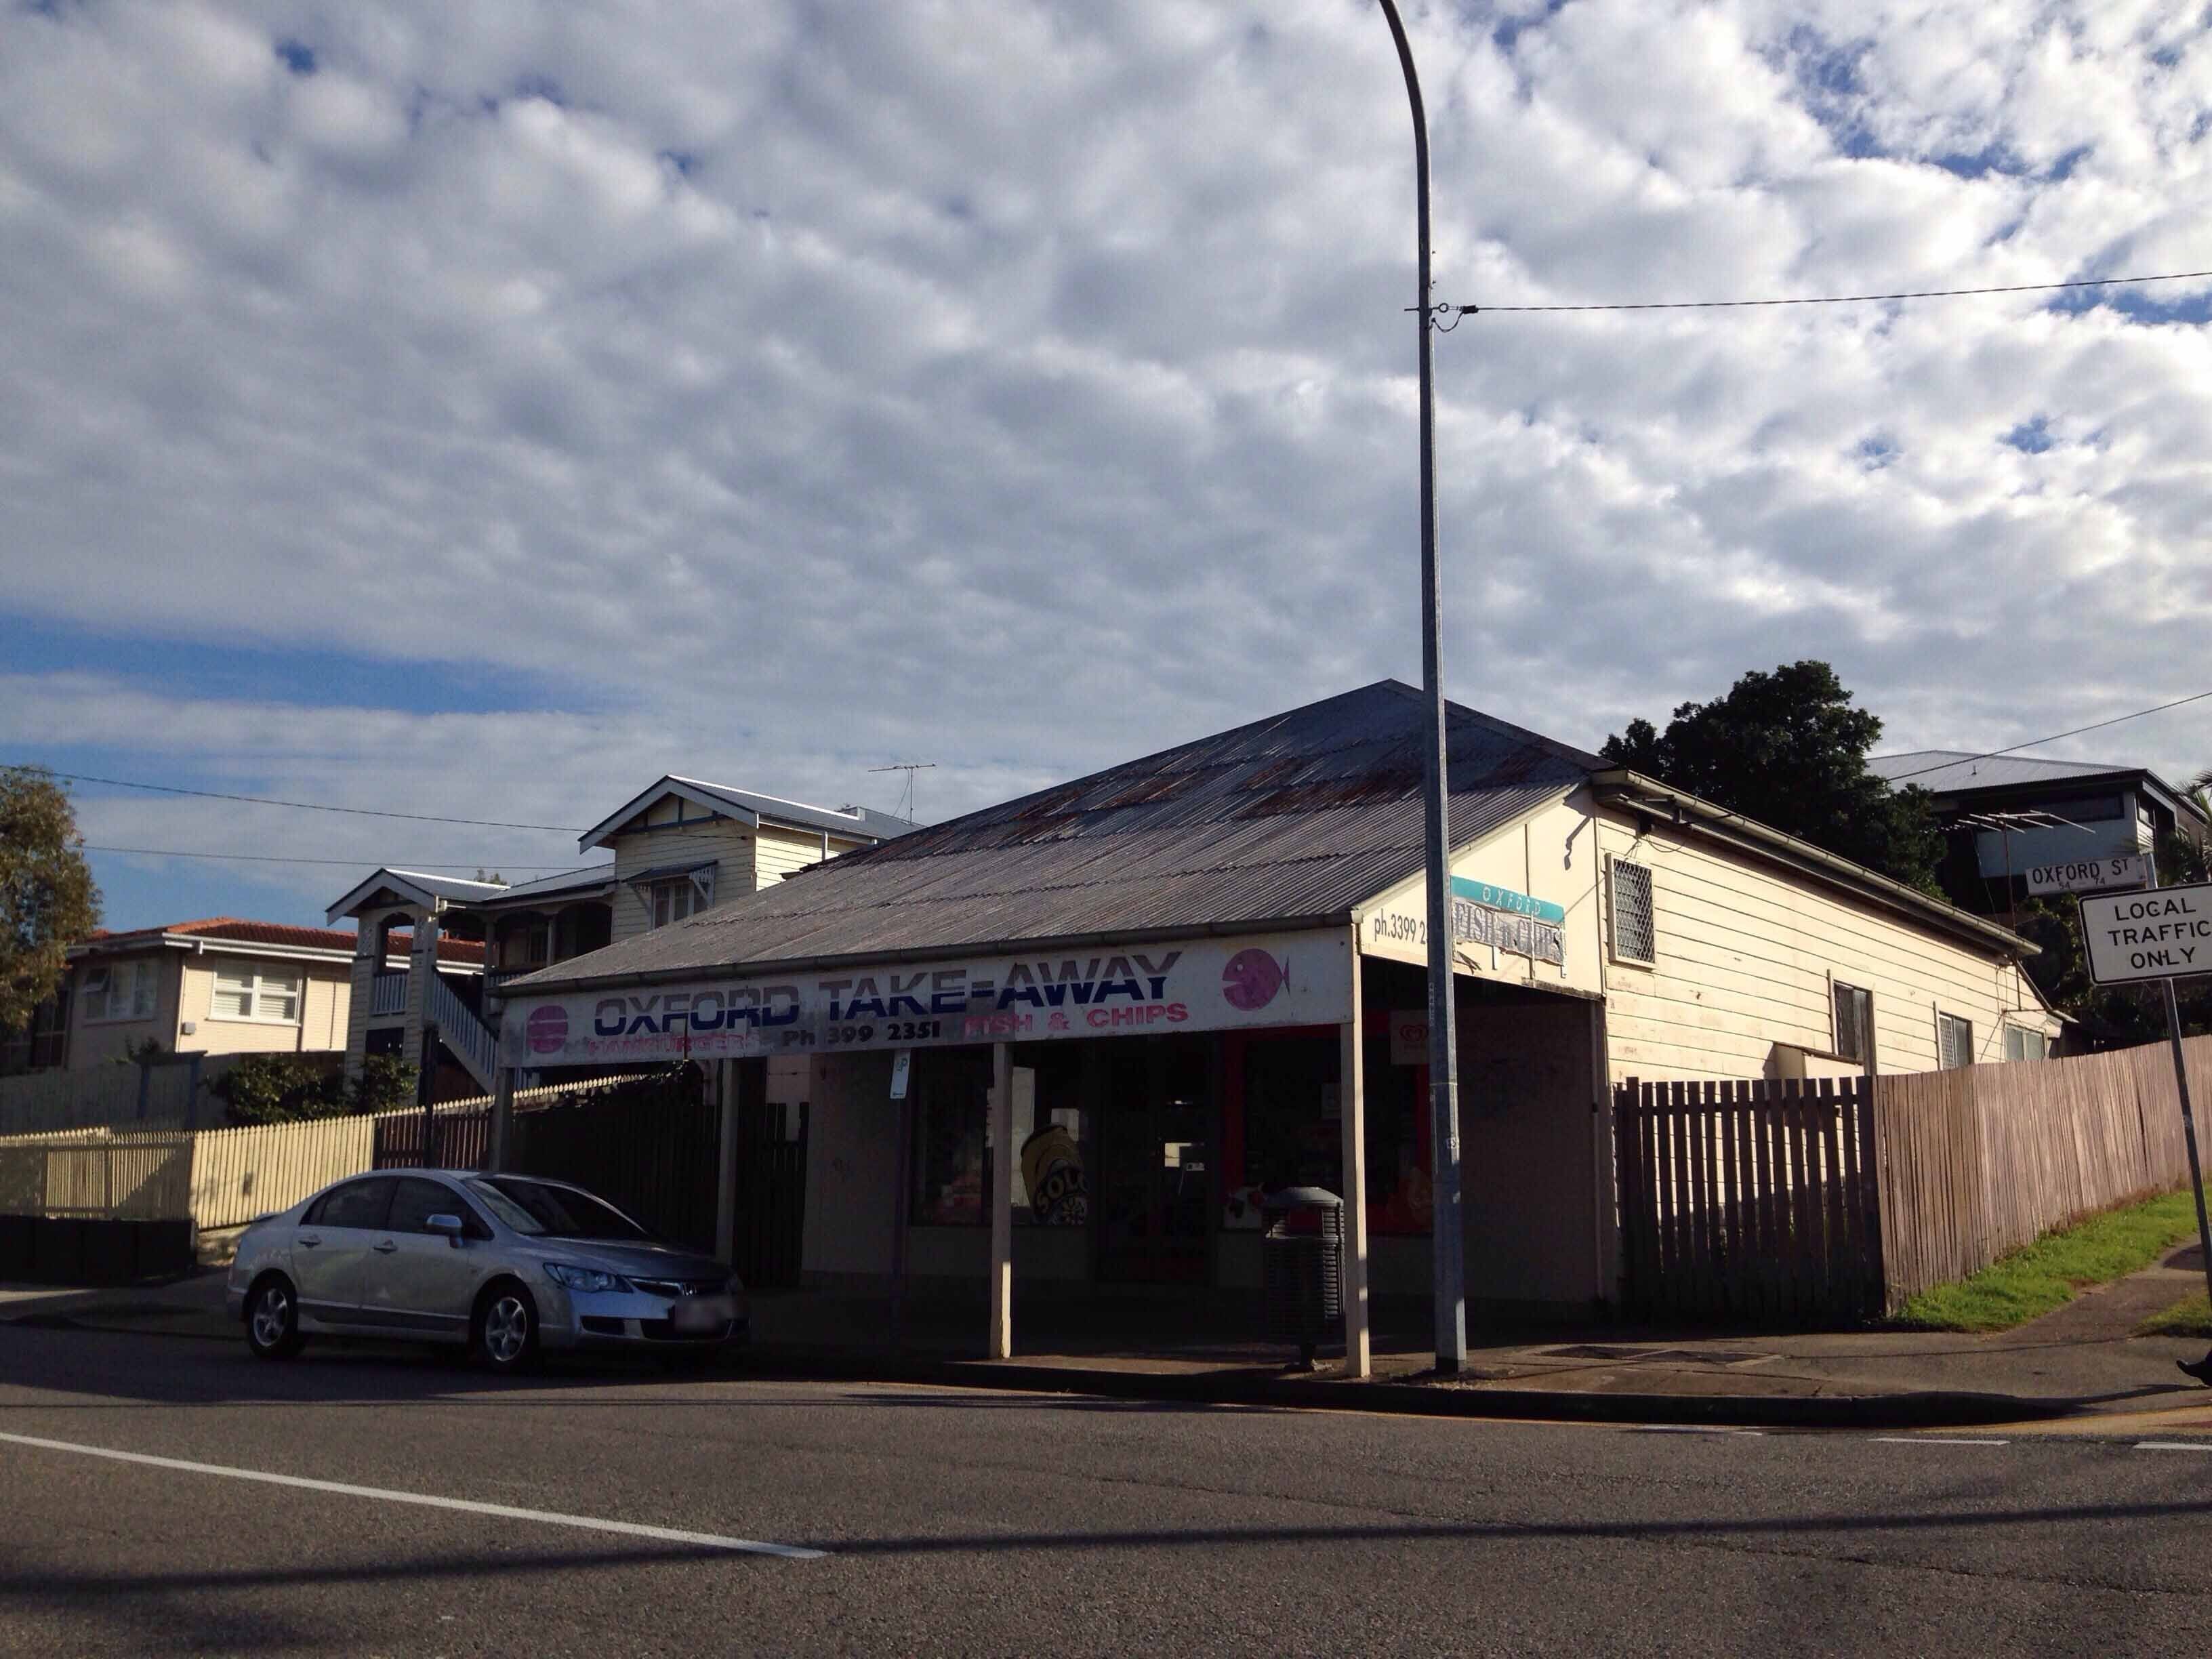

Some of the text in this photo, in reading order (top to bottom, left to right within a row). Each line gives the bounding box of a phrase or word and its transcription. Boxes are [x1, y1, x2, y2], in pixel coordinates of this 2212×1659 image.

[2032, 859, 2129, 884] OXFORD ST
[1482, 886, 1540, 916] OXFORD
[2115, 898, 2196, 921] LOCAL
[1374, 909, 1416, 942] ph.3399
[2108, 920, 2212, 946] TRAFFIC
[2131, 947, 2196, 968] ONLY
[594, 951, 1182, 1036] OXFORD TAKE-AWAY
[966, 1003, 1189, 1036] FISH & CHIPS
[782, 1021, 940, 1048] Ph 399 2351
